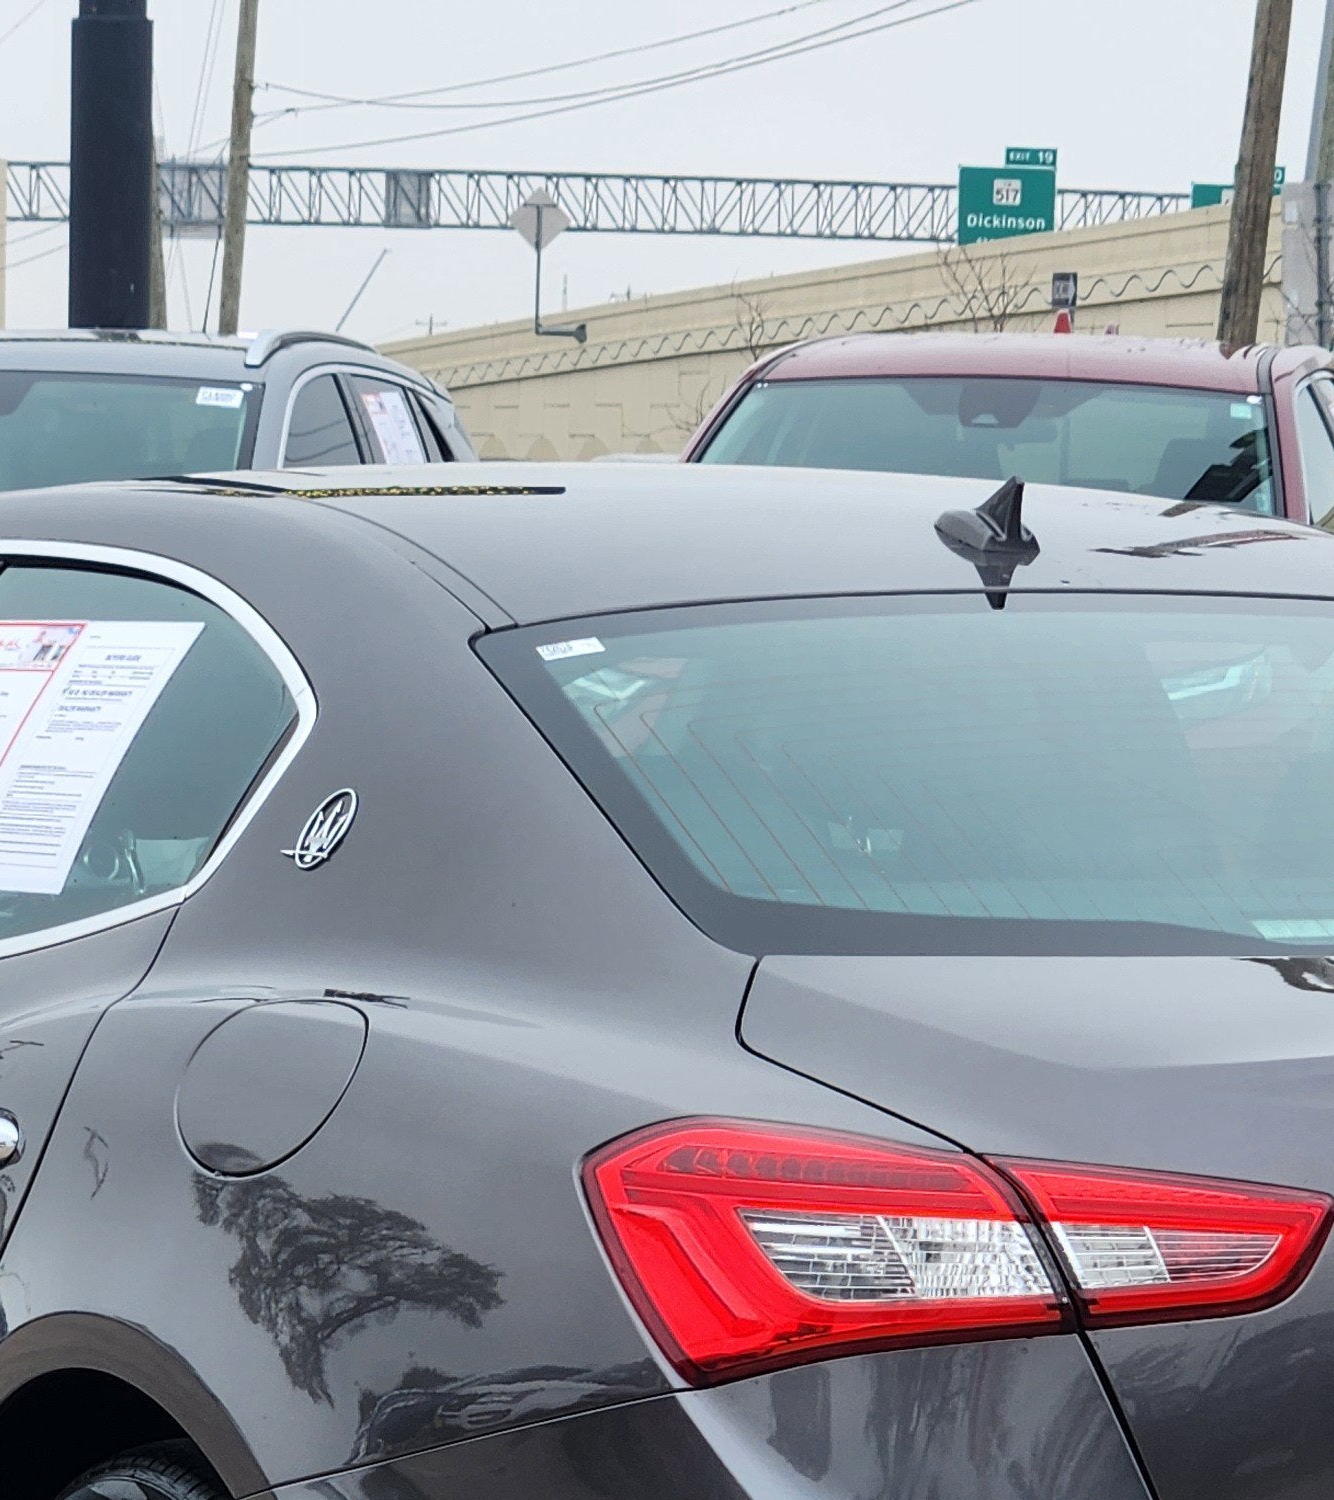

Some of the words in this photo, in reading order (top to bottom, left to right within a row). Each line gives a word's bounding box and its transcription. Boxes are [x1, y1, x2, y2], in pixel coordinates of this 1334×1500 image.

[1038, 151, 1054, 163] 19
[995, 188, 1019, 203] 517
[967, 213, 1046, 230] Dickinson
